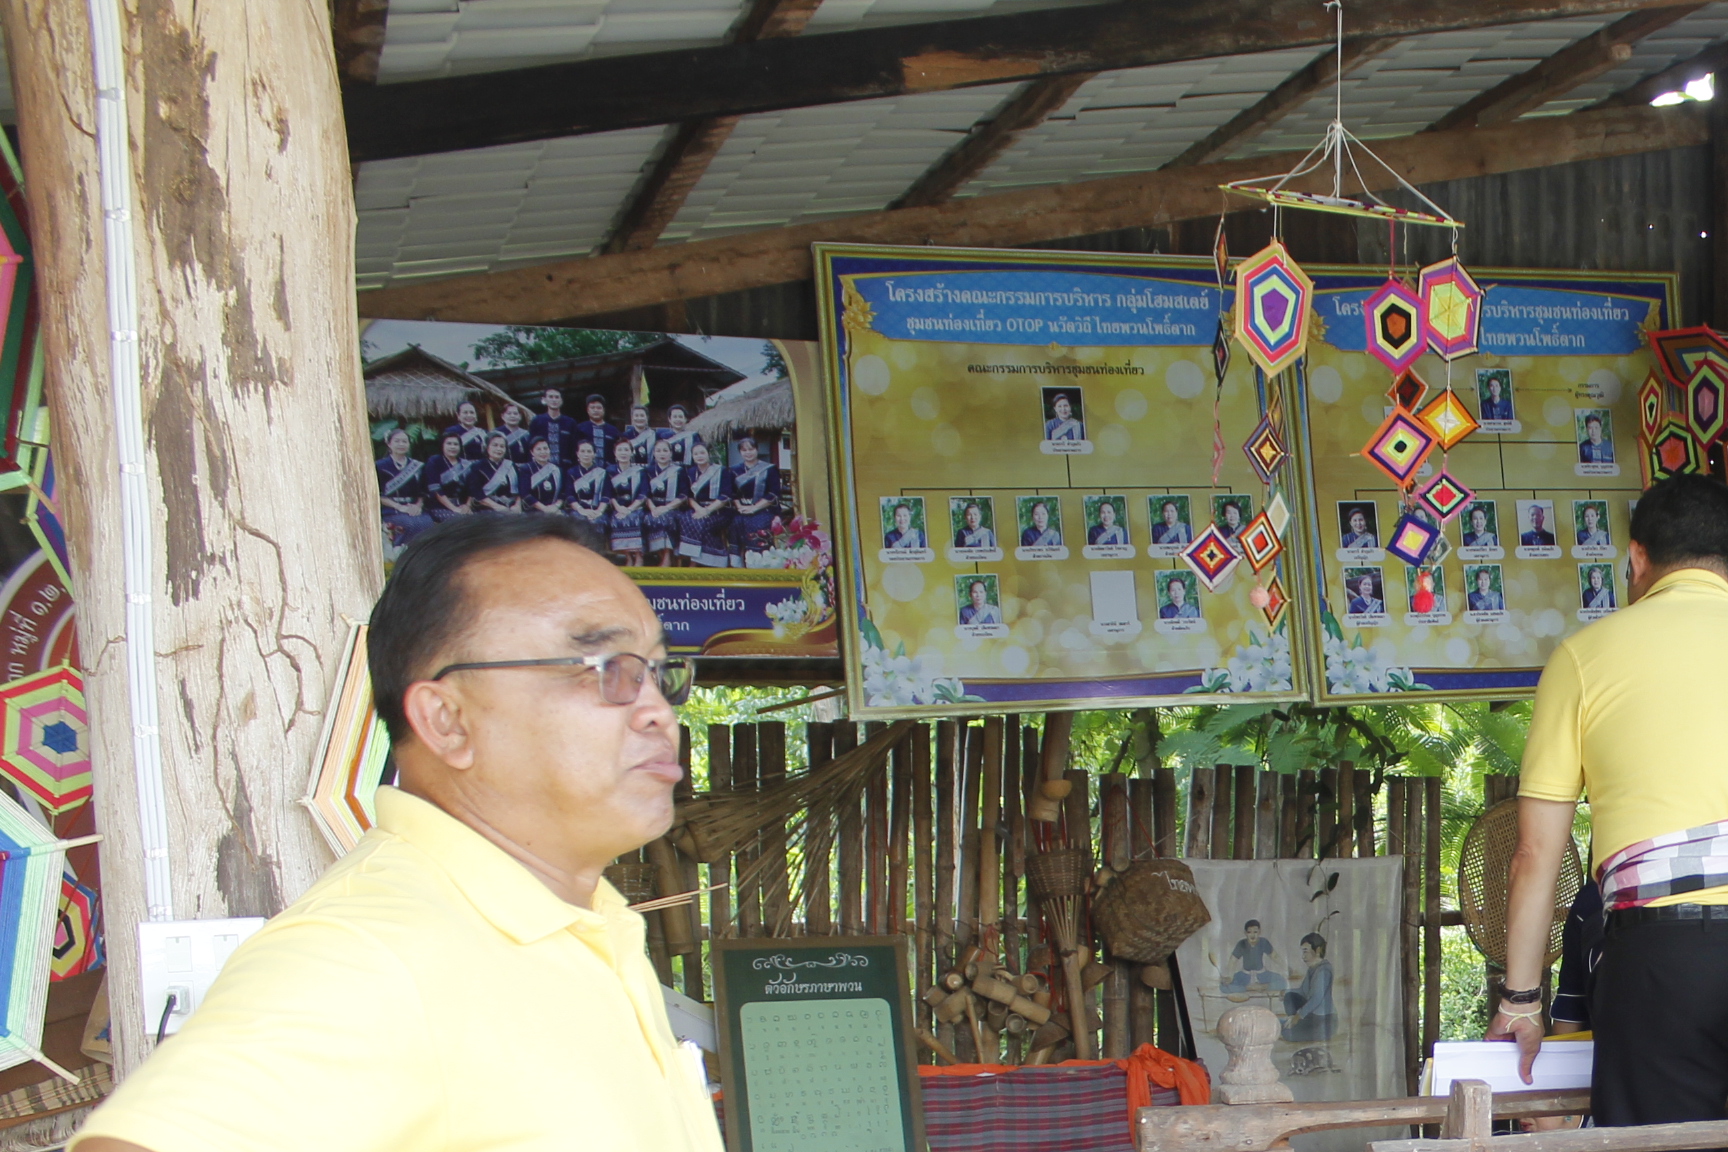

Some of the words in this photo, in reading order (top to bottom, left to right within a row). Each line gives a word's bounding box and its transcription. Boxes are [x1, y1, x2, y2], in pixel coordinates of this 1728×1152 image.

[906, 310, 1002, 335] ชุมชนท่องเที่ยว
[1006, 317, 1043, 332] OTOP
[645, 588, 746, 612] มชนท่องเที่ยว
